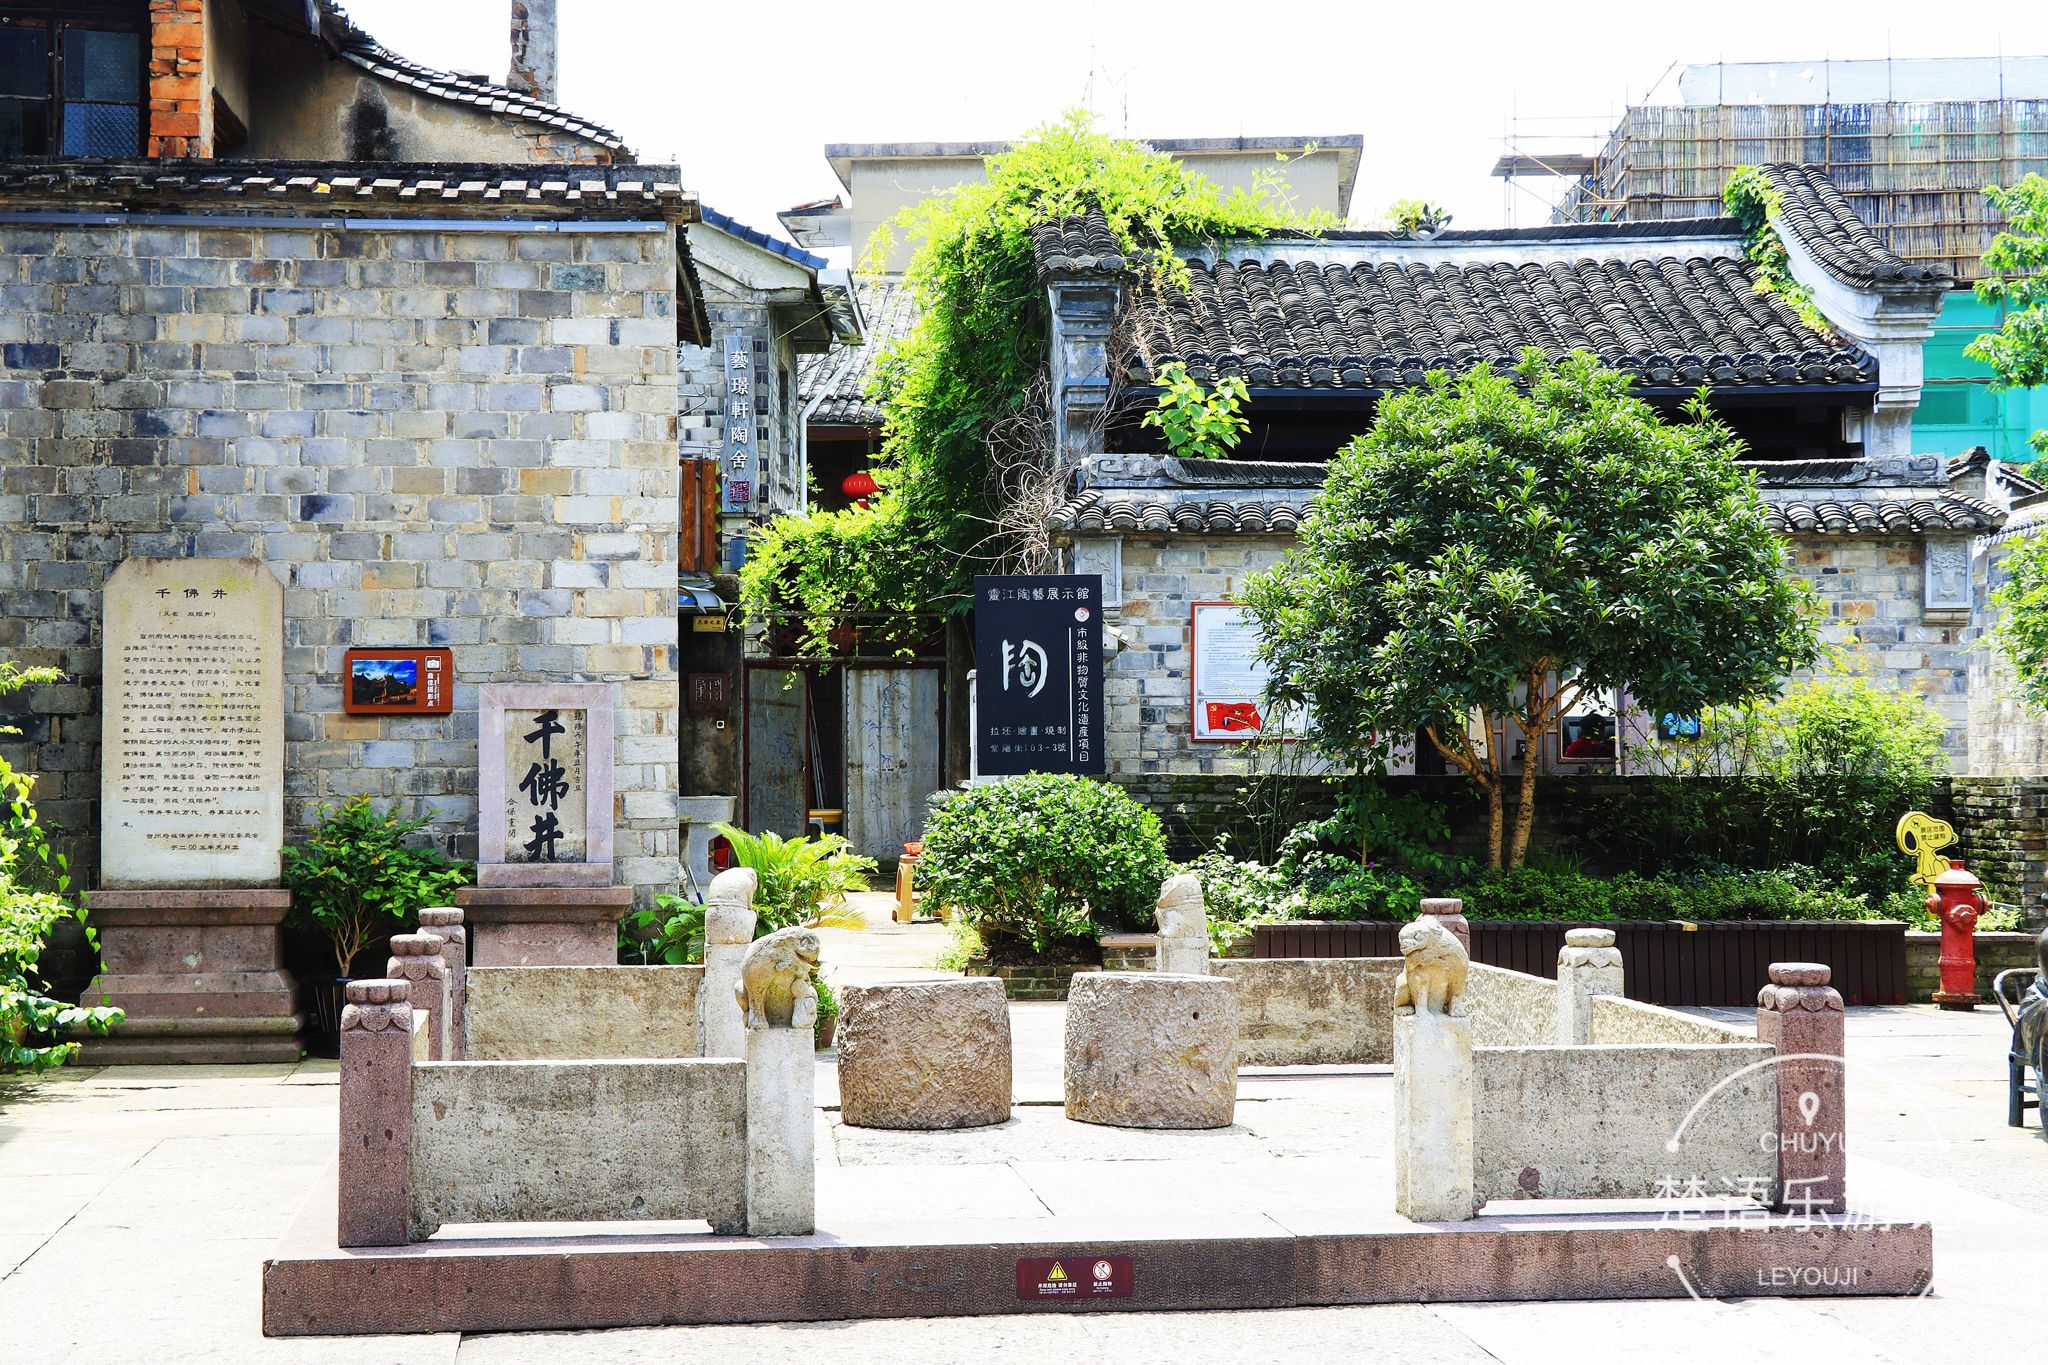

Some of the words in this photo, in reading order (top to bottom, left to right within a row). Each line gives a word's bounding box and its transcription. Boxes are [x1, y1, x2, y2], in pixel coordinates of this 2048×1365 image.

[730, 350, 749, 470] 藝璟軒陶舍
[156, 588, 228, 599] 千佛井
[1001, 638, 1049, 699] 陶
[519, 709, 570, 862] 千佛井
